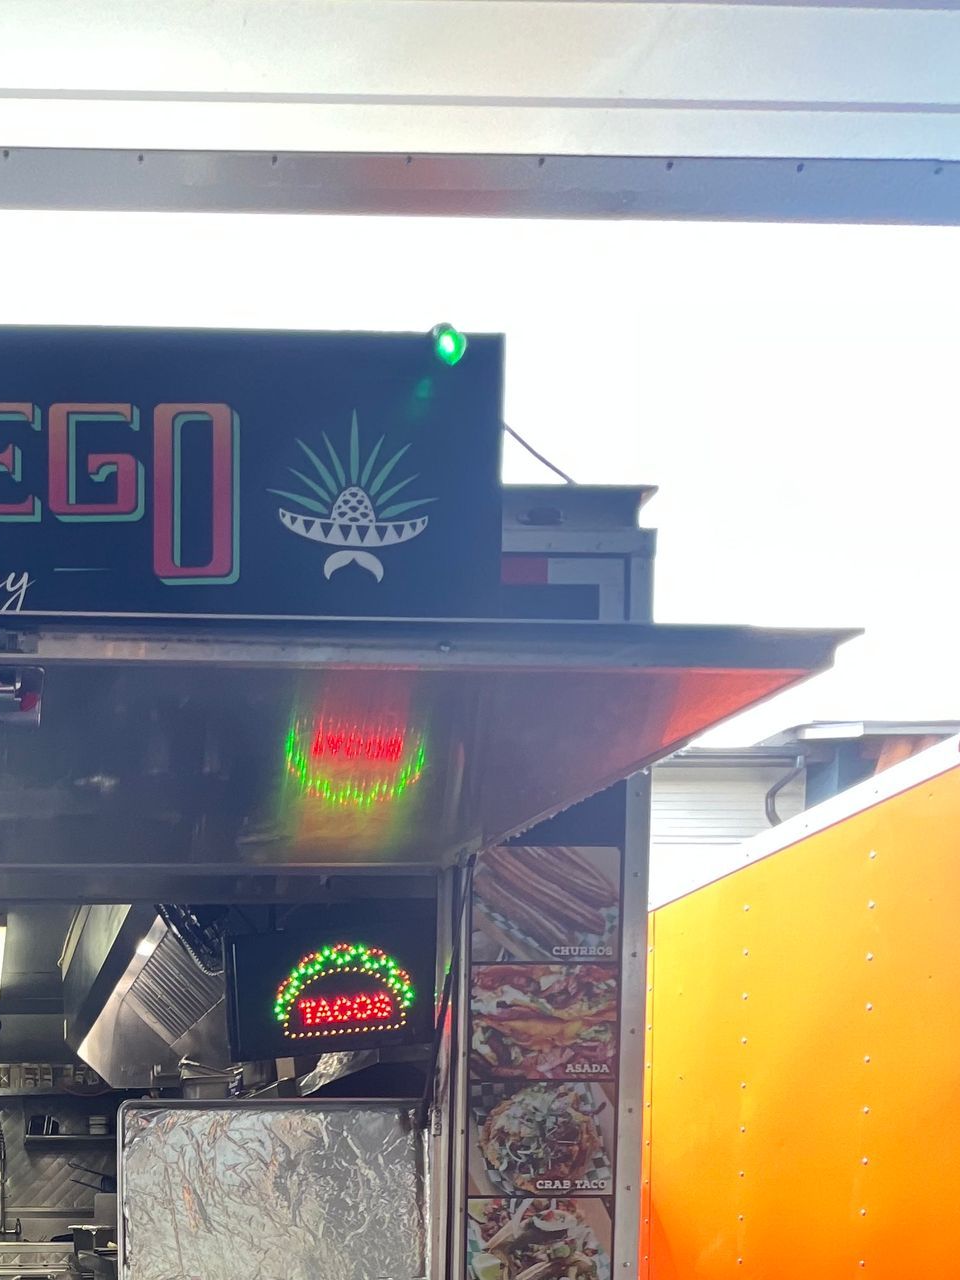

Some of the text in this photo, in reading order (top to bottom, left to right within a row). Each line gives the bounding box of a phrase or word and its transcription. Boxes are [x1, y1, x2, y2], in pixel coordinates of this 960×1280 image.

[552, 946, 613, 956] CHURROS
[299, 993, 392, 1026] TACOS
[565, 1063, 610, 1074] ASADA
[536, 1179, 607, 1190] CRAB TACO
